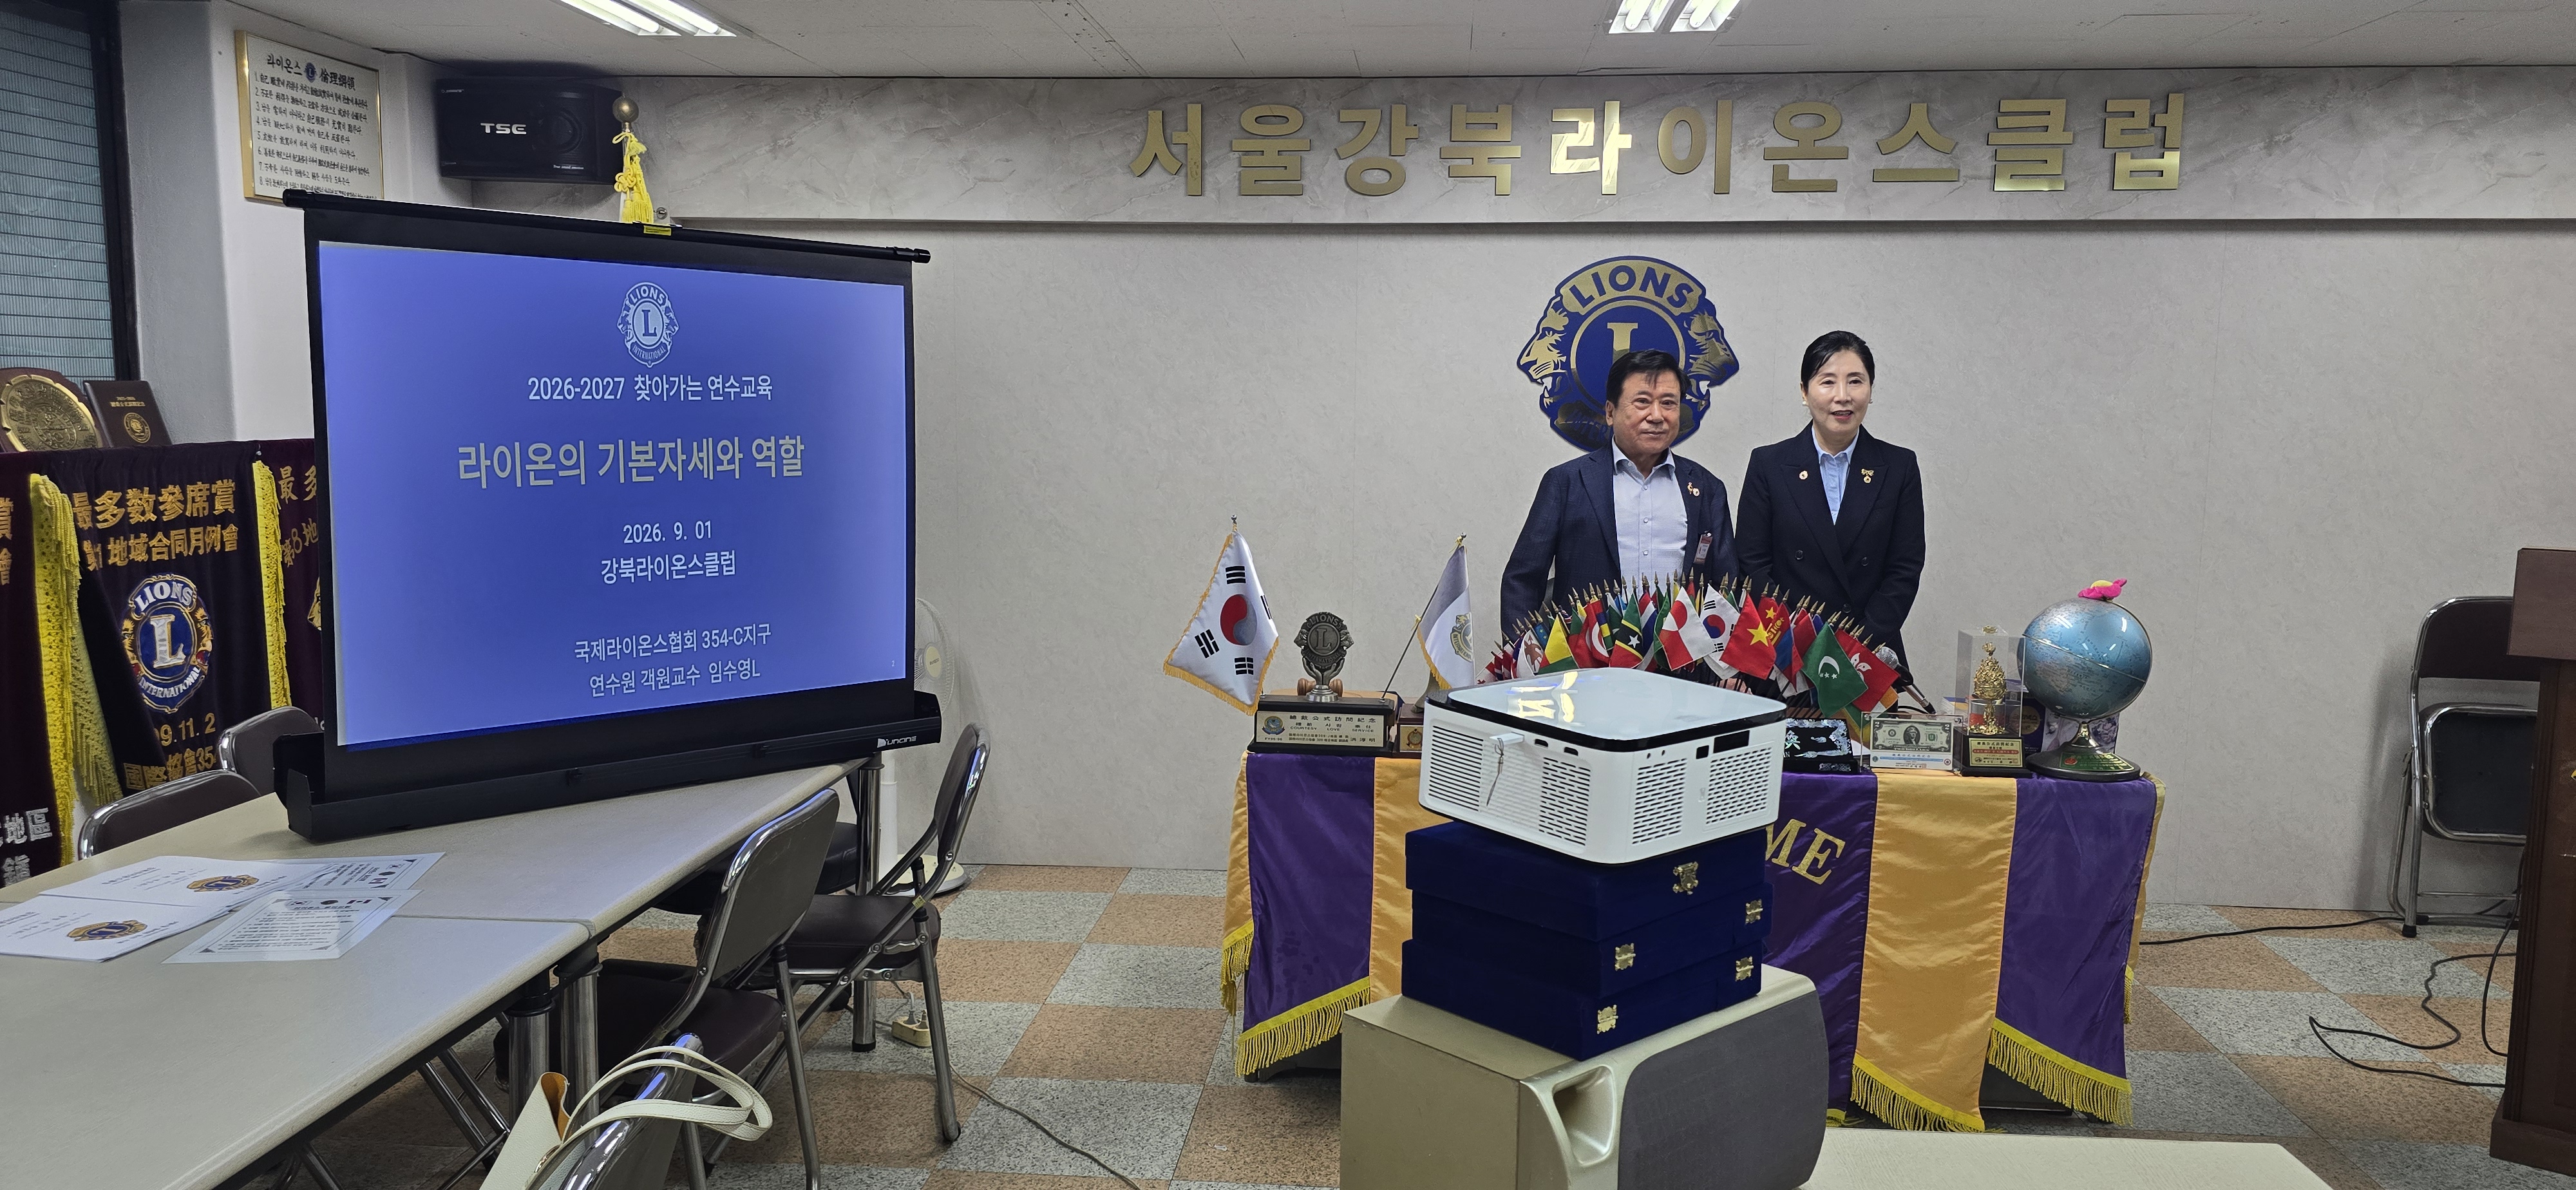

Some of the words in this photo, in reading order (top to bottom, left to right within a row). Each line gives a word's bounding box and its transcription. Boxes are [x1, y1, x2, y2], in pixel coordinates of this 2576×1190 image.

[267, 53, 302, 75] 라이온스
[480, 123, 527, 135] TSE
[1128, 93, 2185, 197] 서울강북라이온스클럽
[630, 286, 665, 305] LIONS
[1568, 265, 1695, 310] LIONS
[641, 309, 658, 337] L
[632, 345, 666, 360] INTERNATIONAL
[528, 377, 625, 401] 2026-2027
[634, 374, 703, 402] 찾아가는
[707, 374, 773, 401] 연수교육
[458, 440, 586, 489] 라이온의
[597, 437, 744, 484] 기본자세와
[751, 435, 805, 478] 역할
[622, 523, 666, 544] 2026.
[673, 522, 688, 541] 9.
[695, 520, 713, 540] 01
[600, 550, 737, 585] 강북라이온스클럽
[135, 581, 193, 612] LIONS
[1309, 614, 1339, 626] LIONS
[149, 614, 187, 668] L
[574, 628, 698, 663] 국제라이온스협회
[701, 623, 772, 650] 354-C지구
[1315, 628, 1332, 650] L
[138, 666, 202, 699] INTERNATIONAL
[589, 670, 636, 697] 연수원
[640, 663, 701, 692] 객원교수
[708, 657, 761, 685] 임수영L
[123, 745, 217, 784] 國際協會35
[0, 807, 53, 847] 地區
